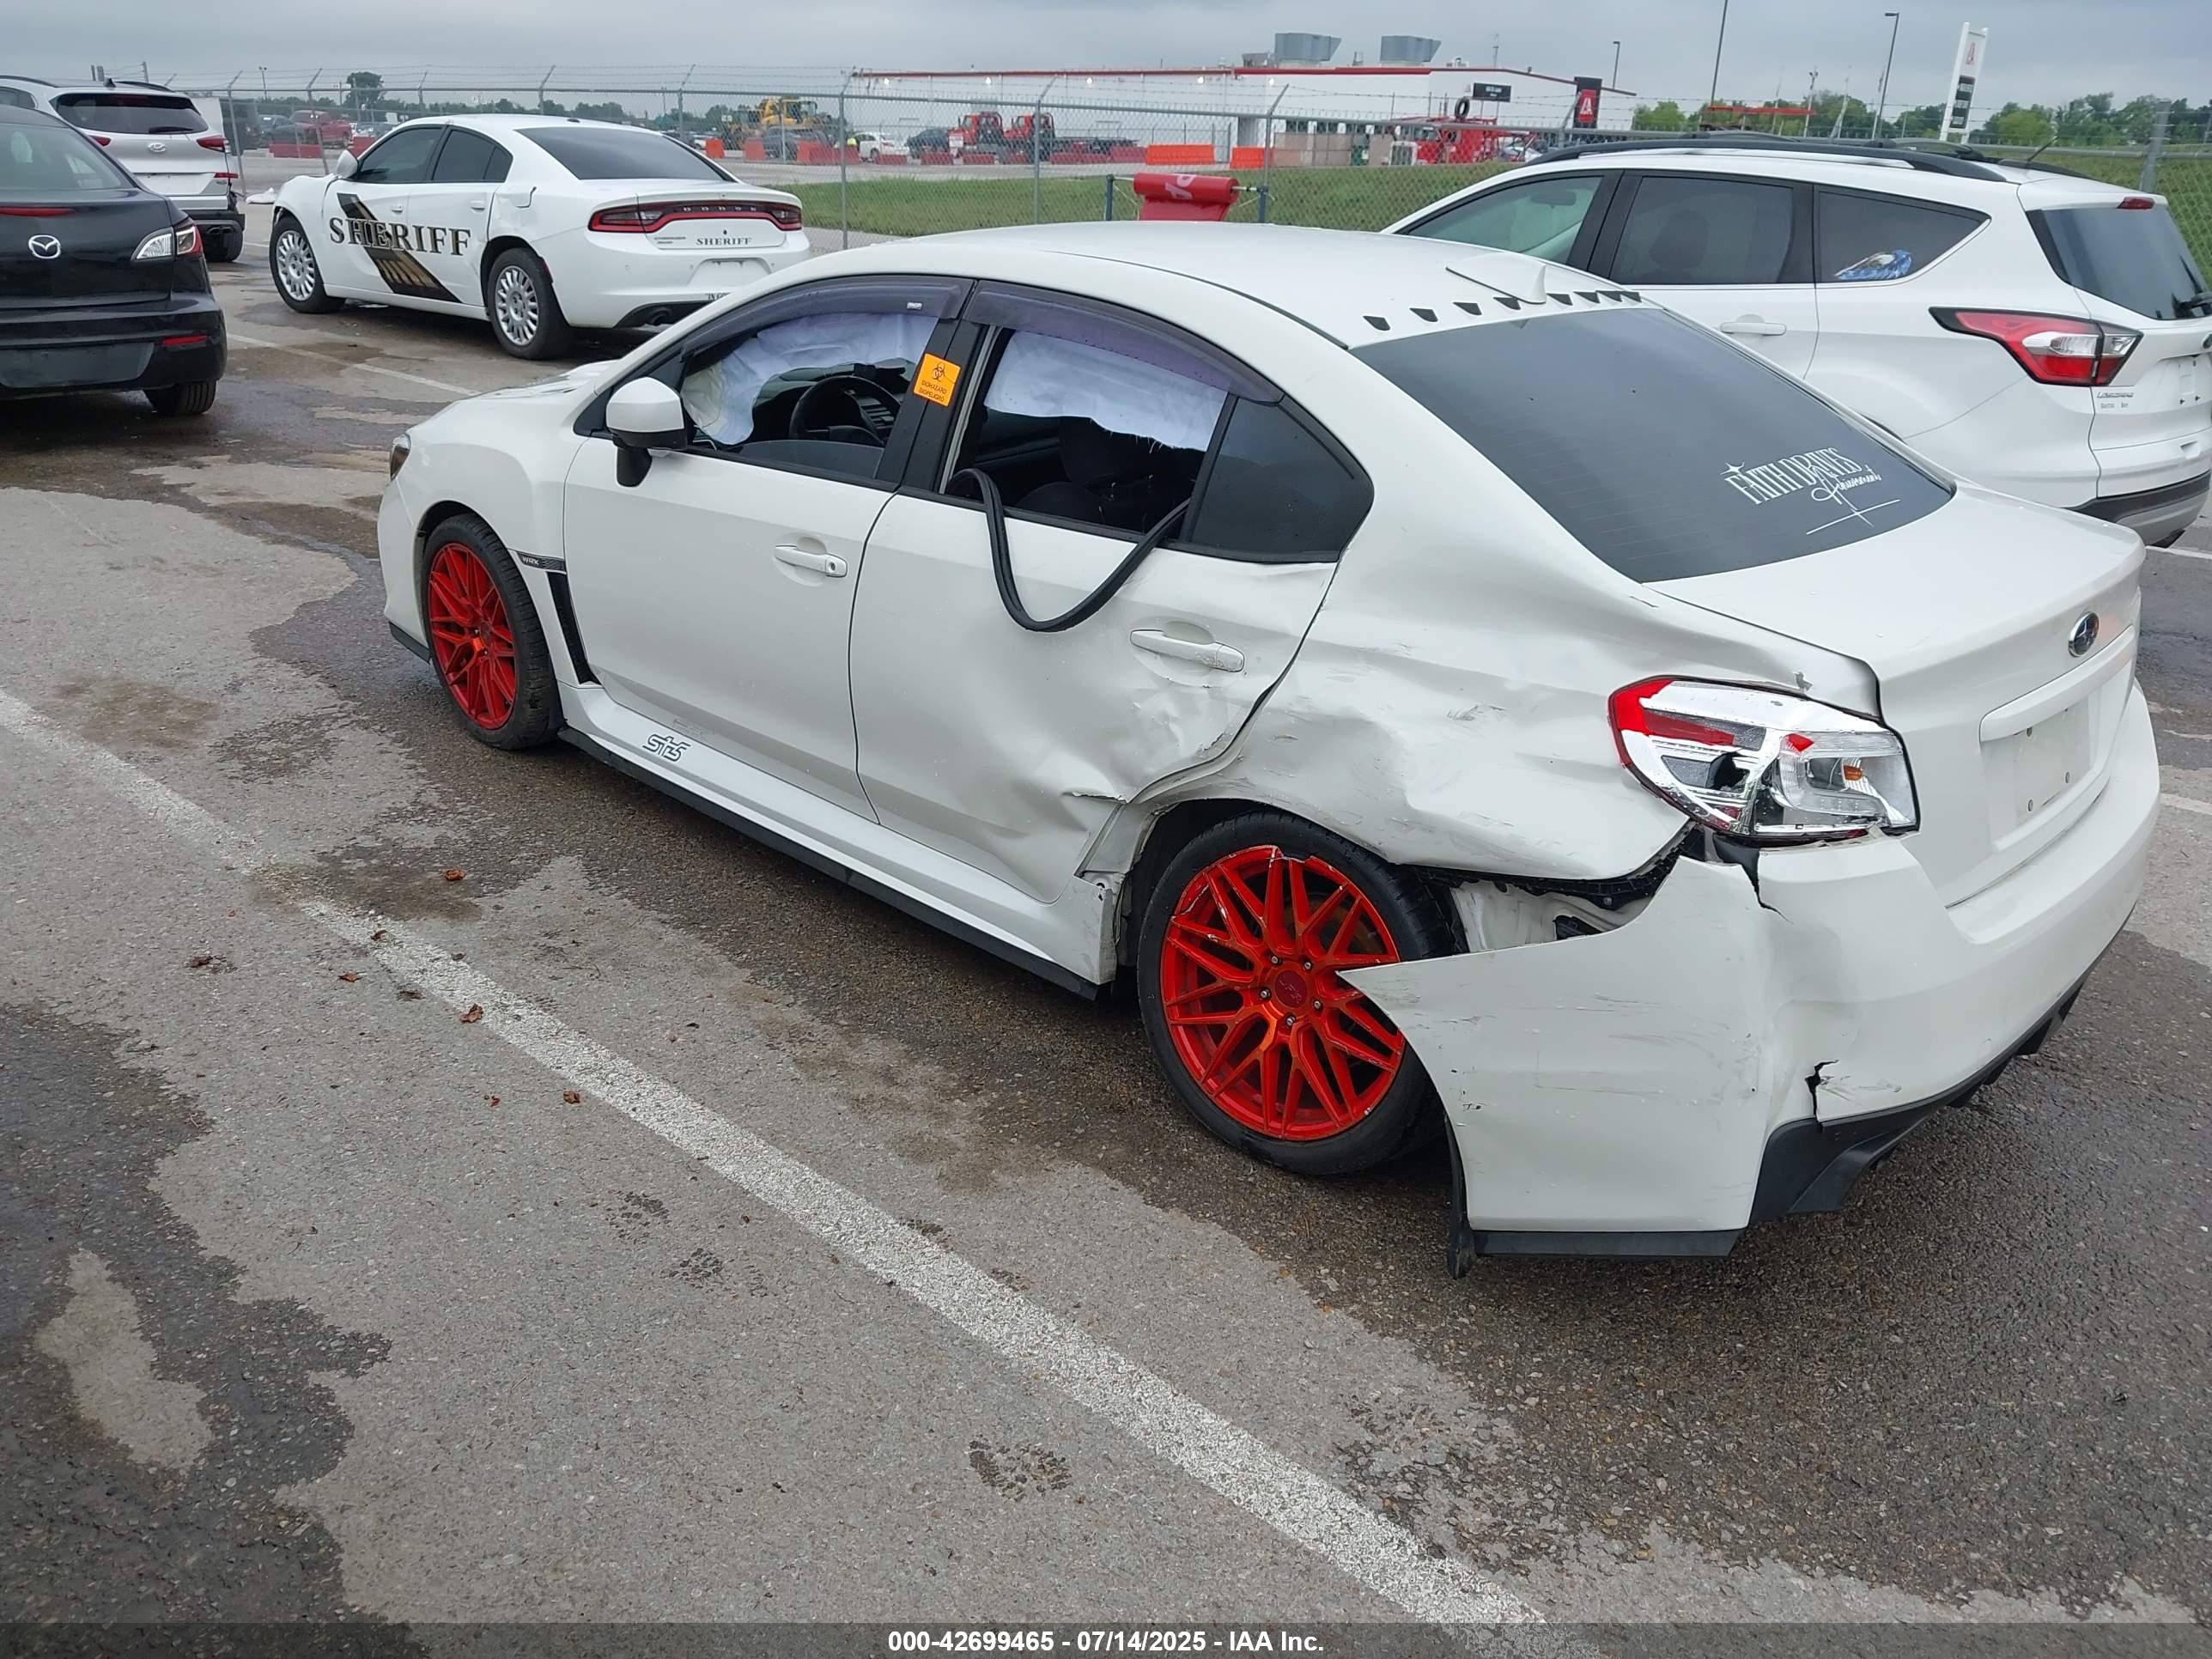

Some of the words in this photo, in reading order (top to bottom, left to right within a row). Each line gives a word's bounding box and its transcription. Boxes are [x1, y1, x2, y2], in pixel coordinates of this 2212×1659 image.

[329, 216, 471, 256] SHERIFF
[696, 237, 752, 246] SHERIFF
[1724, 464, 1804, 505] FAITH
[1778, 447, 1863, 486] DRIVES
[522, 556, 540, 566] WRX
